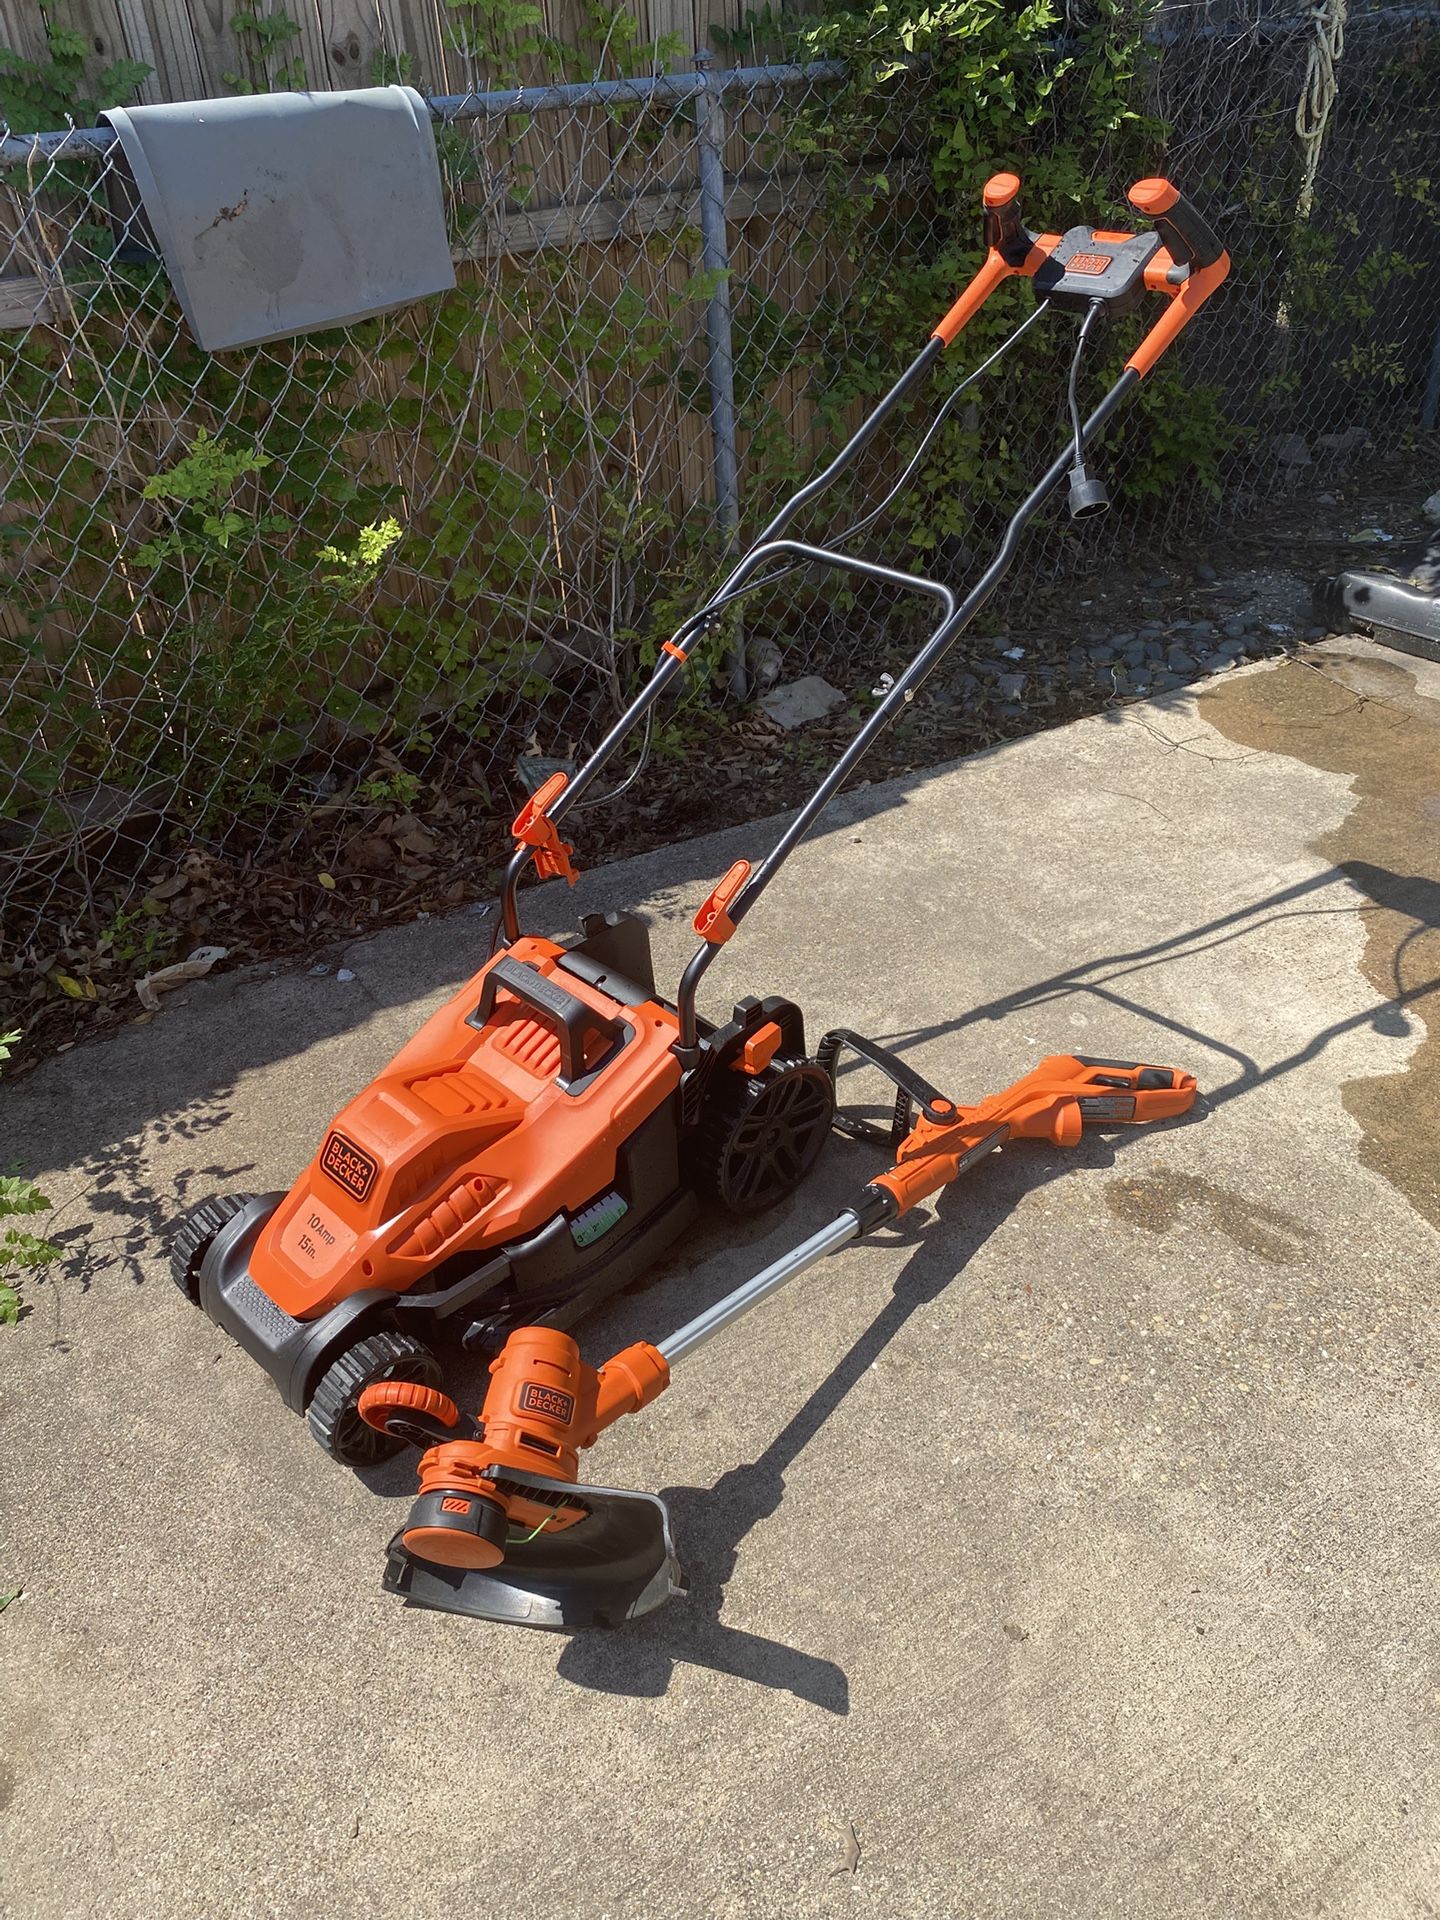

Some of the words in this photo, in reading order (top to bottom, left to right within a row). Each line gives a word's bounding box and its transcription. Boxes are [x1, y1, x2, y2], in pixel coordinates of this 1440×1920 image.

[332, 1142, 368, 1175] BLACK+
[327, 1153, 365, 1191] DECKER
[298, 1234, 315, 1259] 15in.
[529, 1398, 567, 1417] DECKER
[530, 1389, 567, 1406] BLACK+
